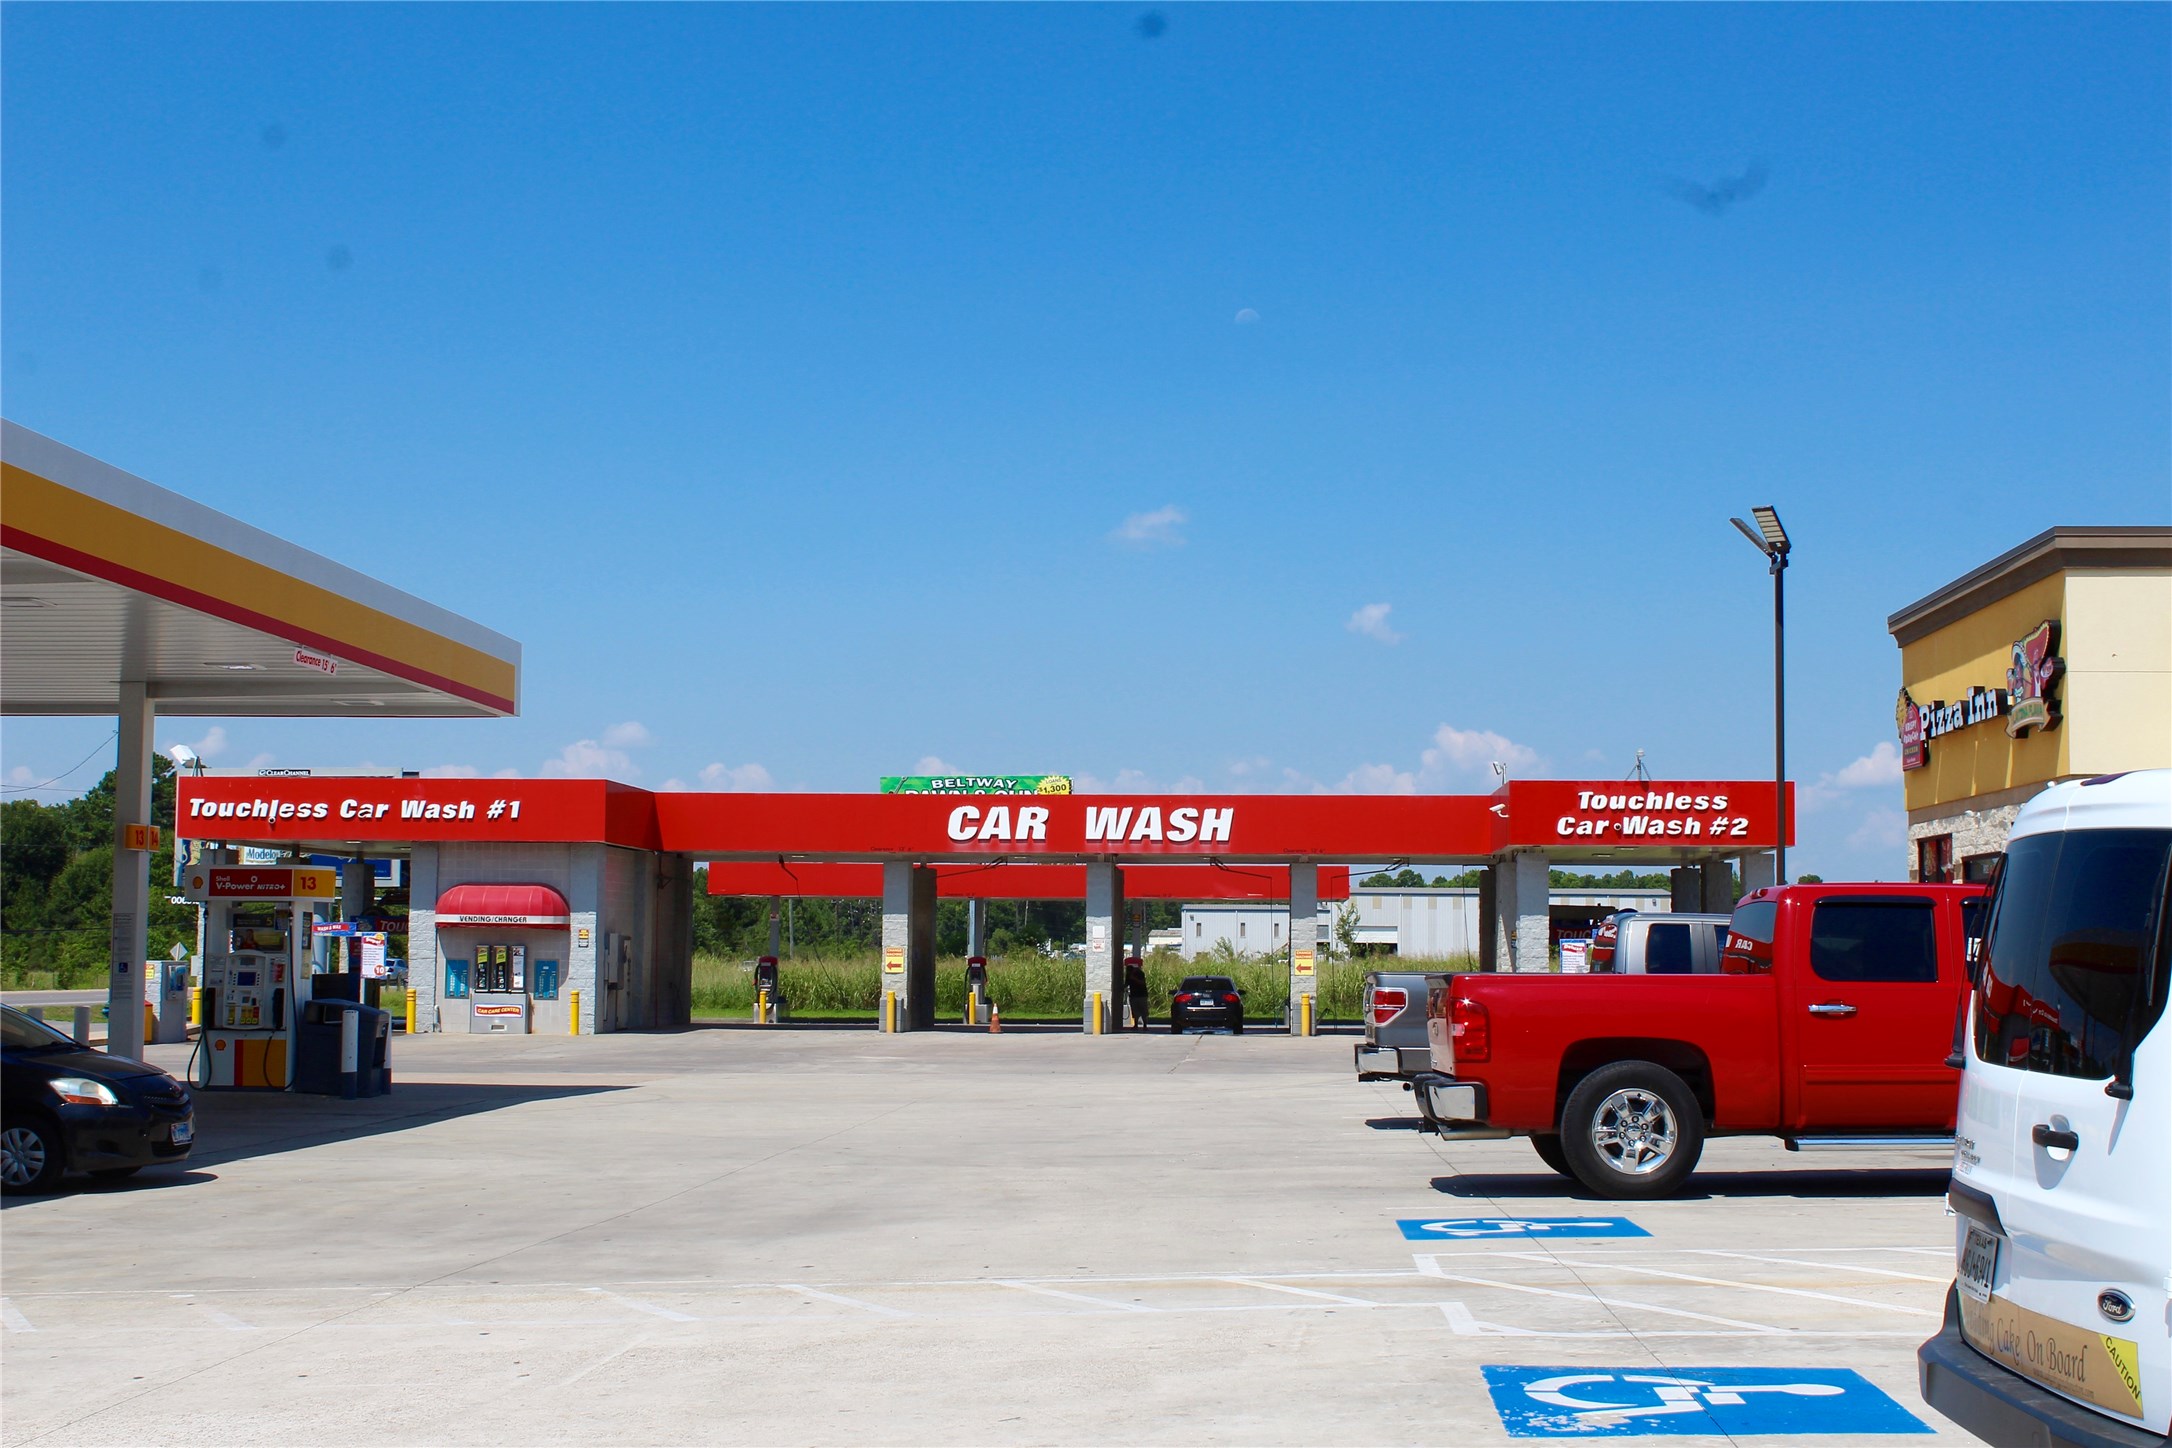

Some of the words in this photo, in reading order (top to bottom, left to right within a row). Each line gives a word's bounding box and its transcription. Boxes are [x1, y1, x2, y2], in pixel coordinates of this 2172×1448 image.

[296, 651, 321, 666] Clearance
[1919, 700, 1963, 741] Pizza
[1967, 687, 1999, 725] Inn
[931, 777, 1018, 789] BELTWAY
[1038, 783, 1067, 794] $1,300
[190, 798, 329, 818] Touchless
[340, 799, 390, 819] Car
[401, 799, 476, 819] Wash
[486, 799, 521, 819] #1
[1578, 791, 1729, 811] Touchless
[948, 805, 1050, 842] CAR
[1085, 806, 1235, 842] WASH
[1556, 816, 1610, 836] Car
[1621, 816, 1701, 836] Wash
[1709, 816, 1750, 836] #2
[135, 829, 145, 846] 13
[151, 830, 159, 847] 14
[246, 848, 277, 860] Modelo
[216, 882, 255, 890] V-Power
[300, 876, 317, 891] 13
[459, 915, 528, 923] VENDING/CHANGER
[2103, 1297, 2123, 1315] Ford
[1997, 1318, 2020, 1367] Cake
[2027, 1330, 2044, 1366] On
[2046, 1337, 2088, 1383] Board
[2105, 1336, 2141, 1400] CAUTION
